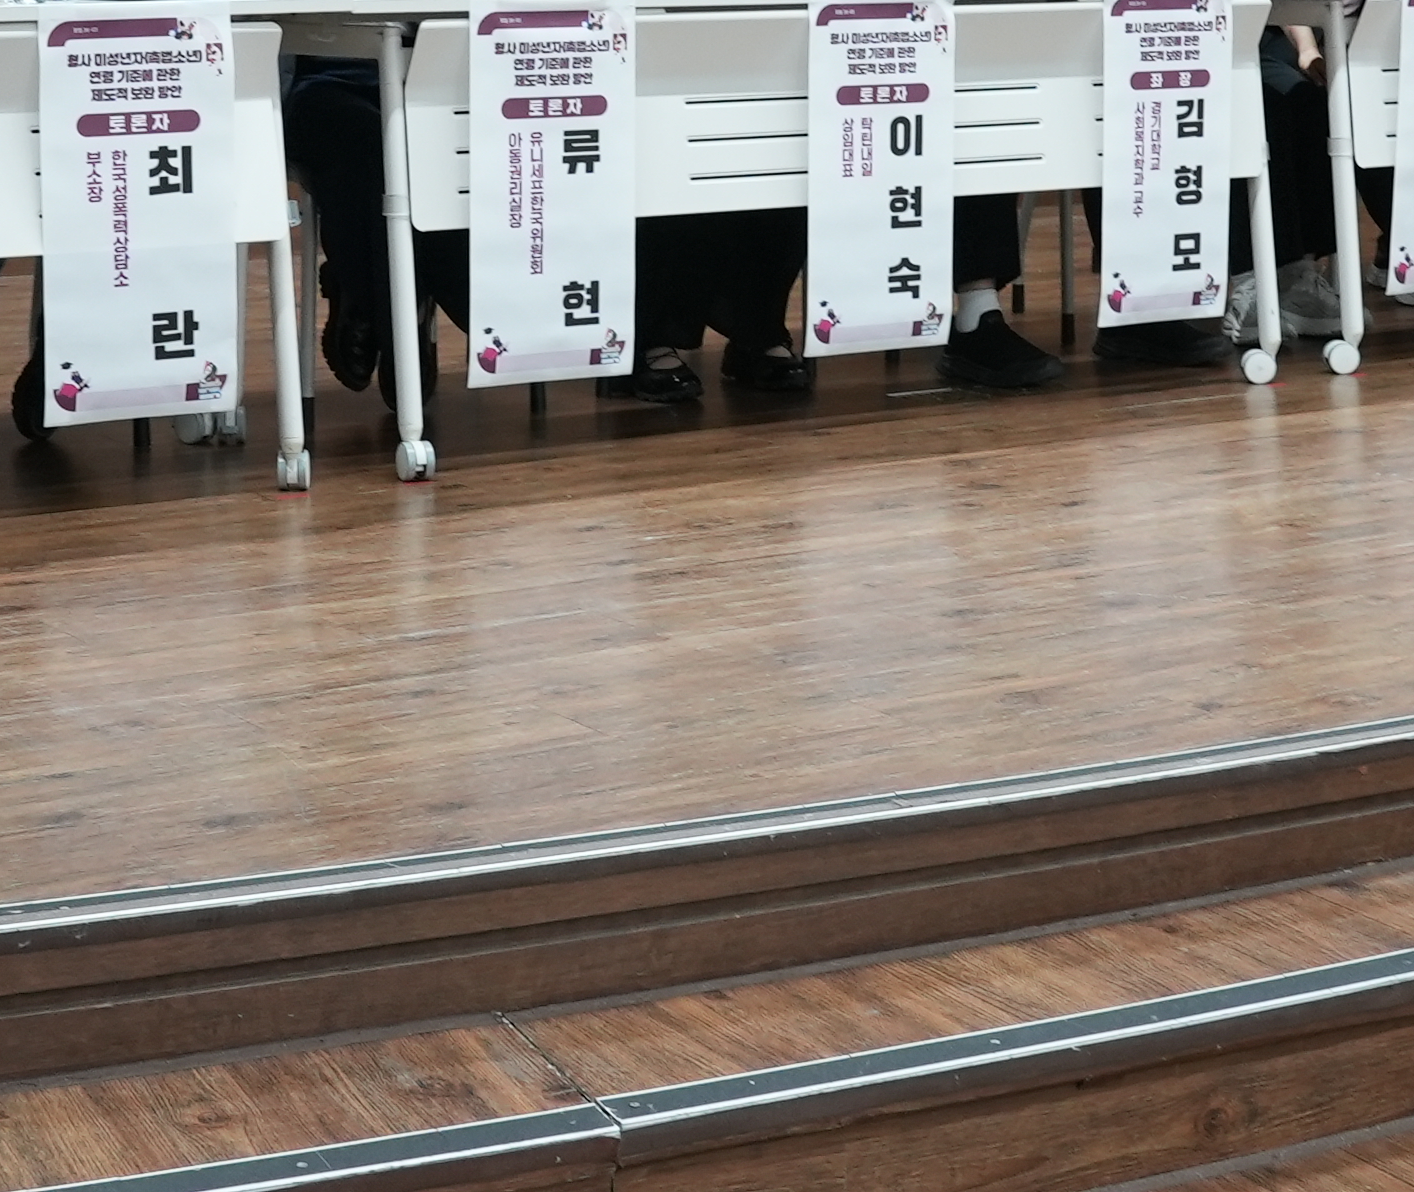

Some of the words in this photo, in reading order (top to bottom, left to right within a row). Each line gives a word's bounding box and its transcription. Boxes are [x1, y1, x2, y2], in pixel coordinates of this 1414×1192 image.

[67, 54, 92, 68] 형사
[95, 50, 203, 66] 미성년자(촉법소년)
[89, 71, 115, 85] 연령
[117, 70, 153, 84] 기준에
[155, 68, 181, 82] 관한
[91, 88, 128, 102] 제도적
[131, 86, 155, 100] 보완
[157, 85, 183, 100] 방안
[108, 112, 171, 134] 토론자
[528, 98, 583, 116] 토론자
[859, 86, 909, 103] 토론자
[841, 117, 855, 178] 상임대표
[861, 116, 874, 178] 탁틴내일
[1149, 101, 1162, 170] 경기대학교
[86, 150, 104, 204] 부소장
[508, 132, 523, 229] 아동권리실장
[530, 131, 545, 276] 유니세프한국위원회
[887, 114, 924, 300] 이현숙
[1171, 98, 1205, 272] 김형모
[111, 149, 130, 288] 한국성폭력상담소
[562, 128, 601, 327] 류현
[148, 145, 199, 361] 최란
